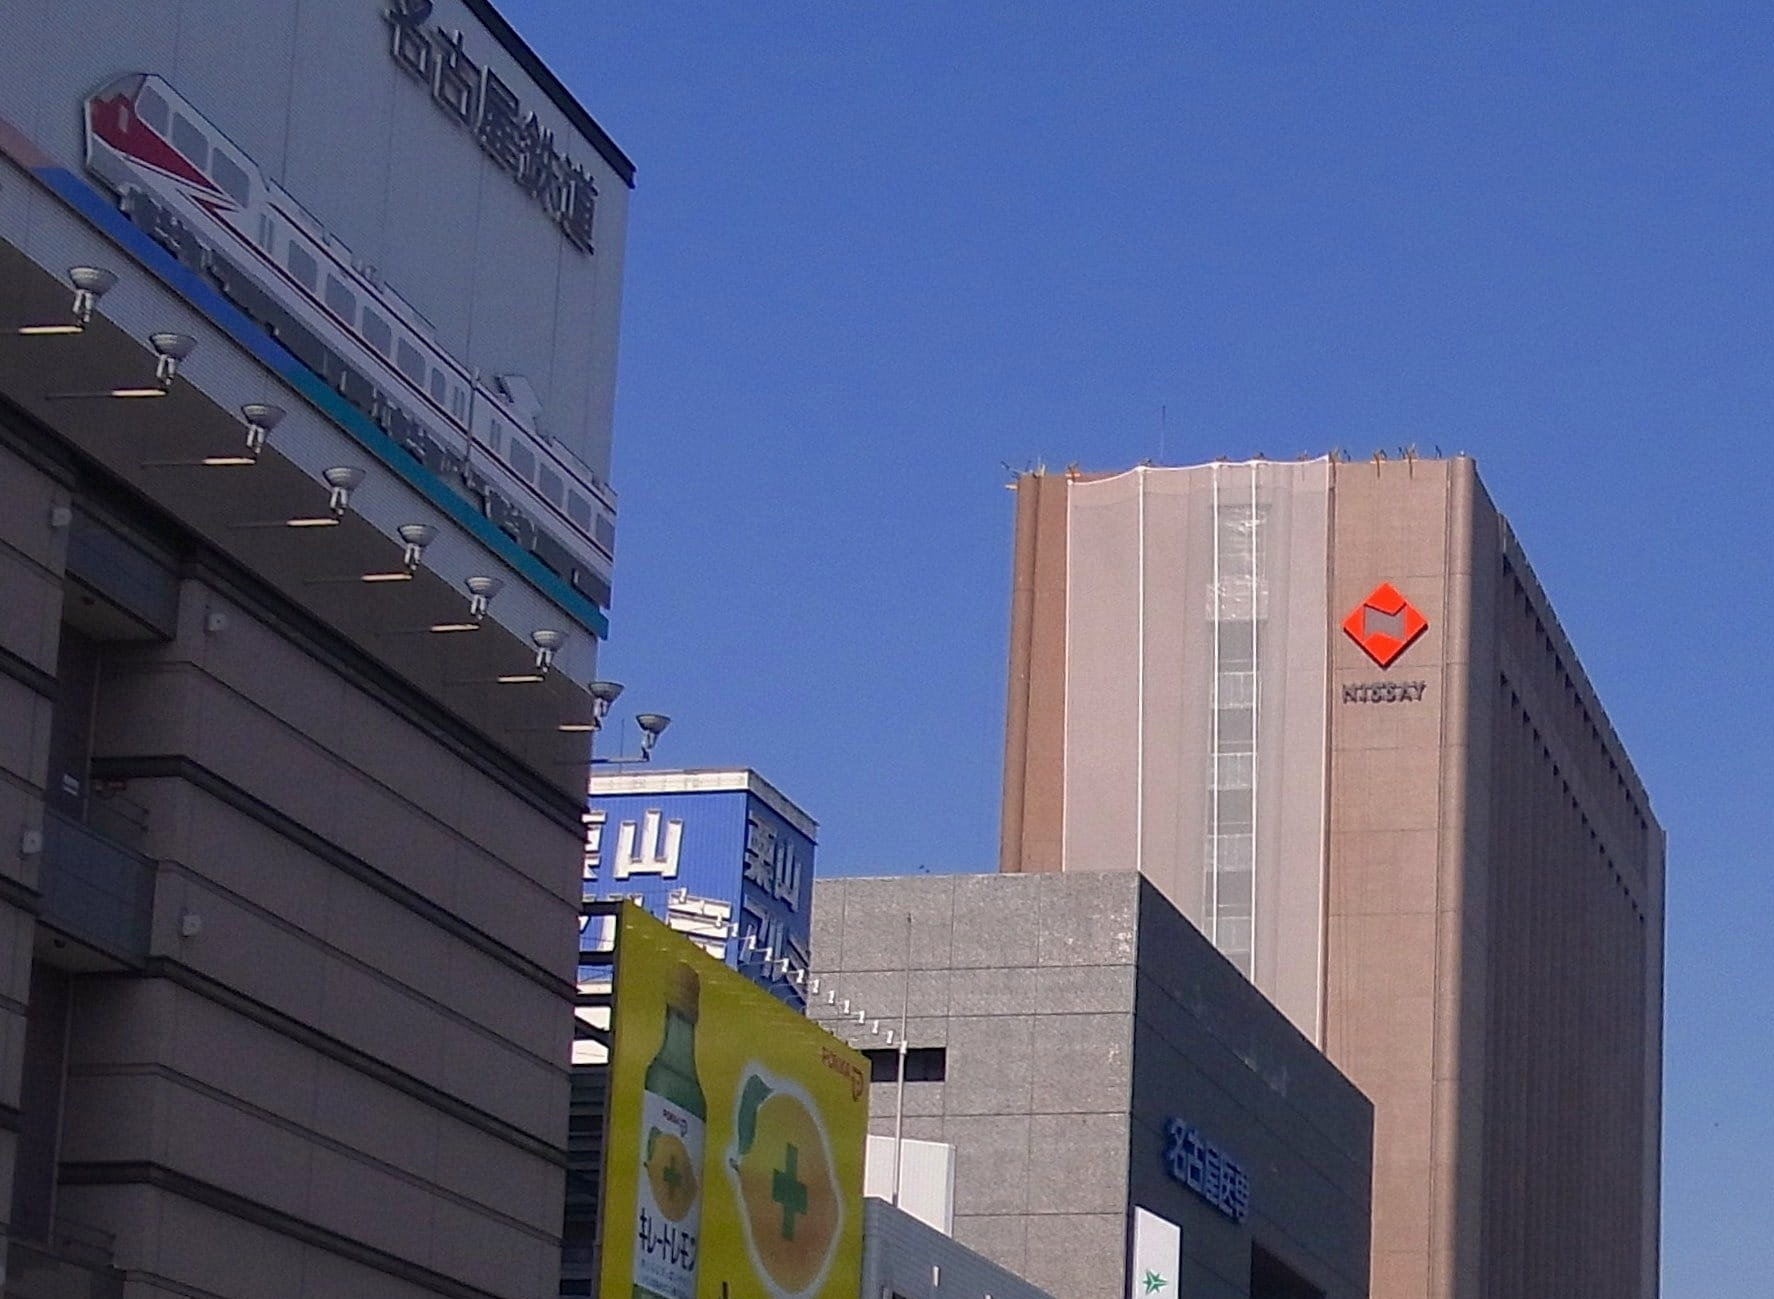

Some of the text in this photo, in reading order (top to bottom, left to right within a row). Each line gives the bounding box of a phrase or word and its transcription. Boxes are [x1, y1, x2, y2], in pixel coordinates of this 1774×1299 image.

[1342, 681, 1427, 704] NISSAY
[1169, 1118, 1249, 1221] 名古屋医専
